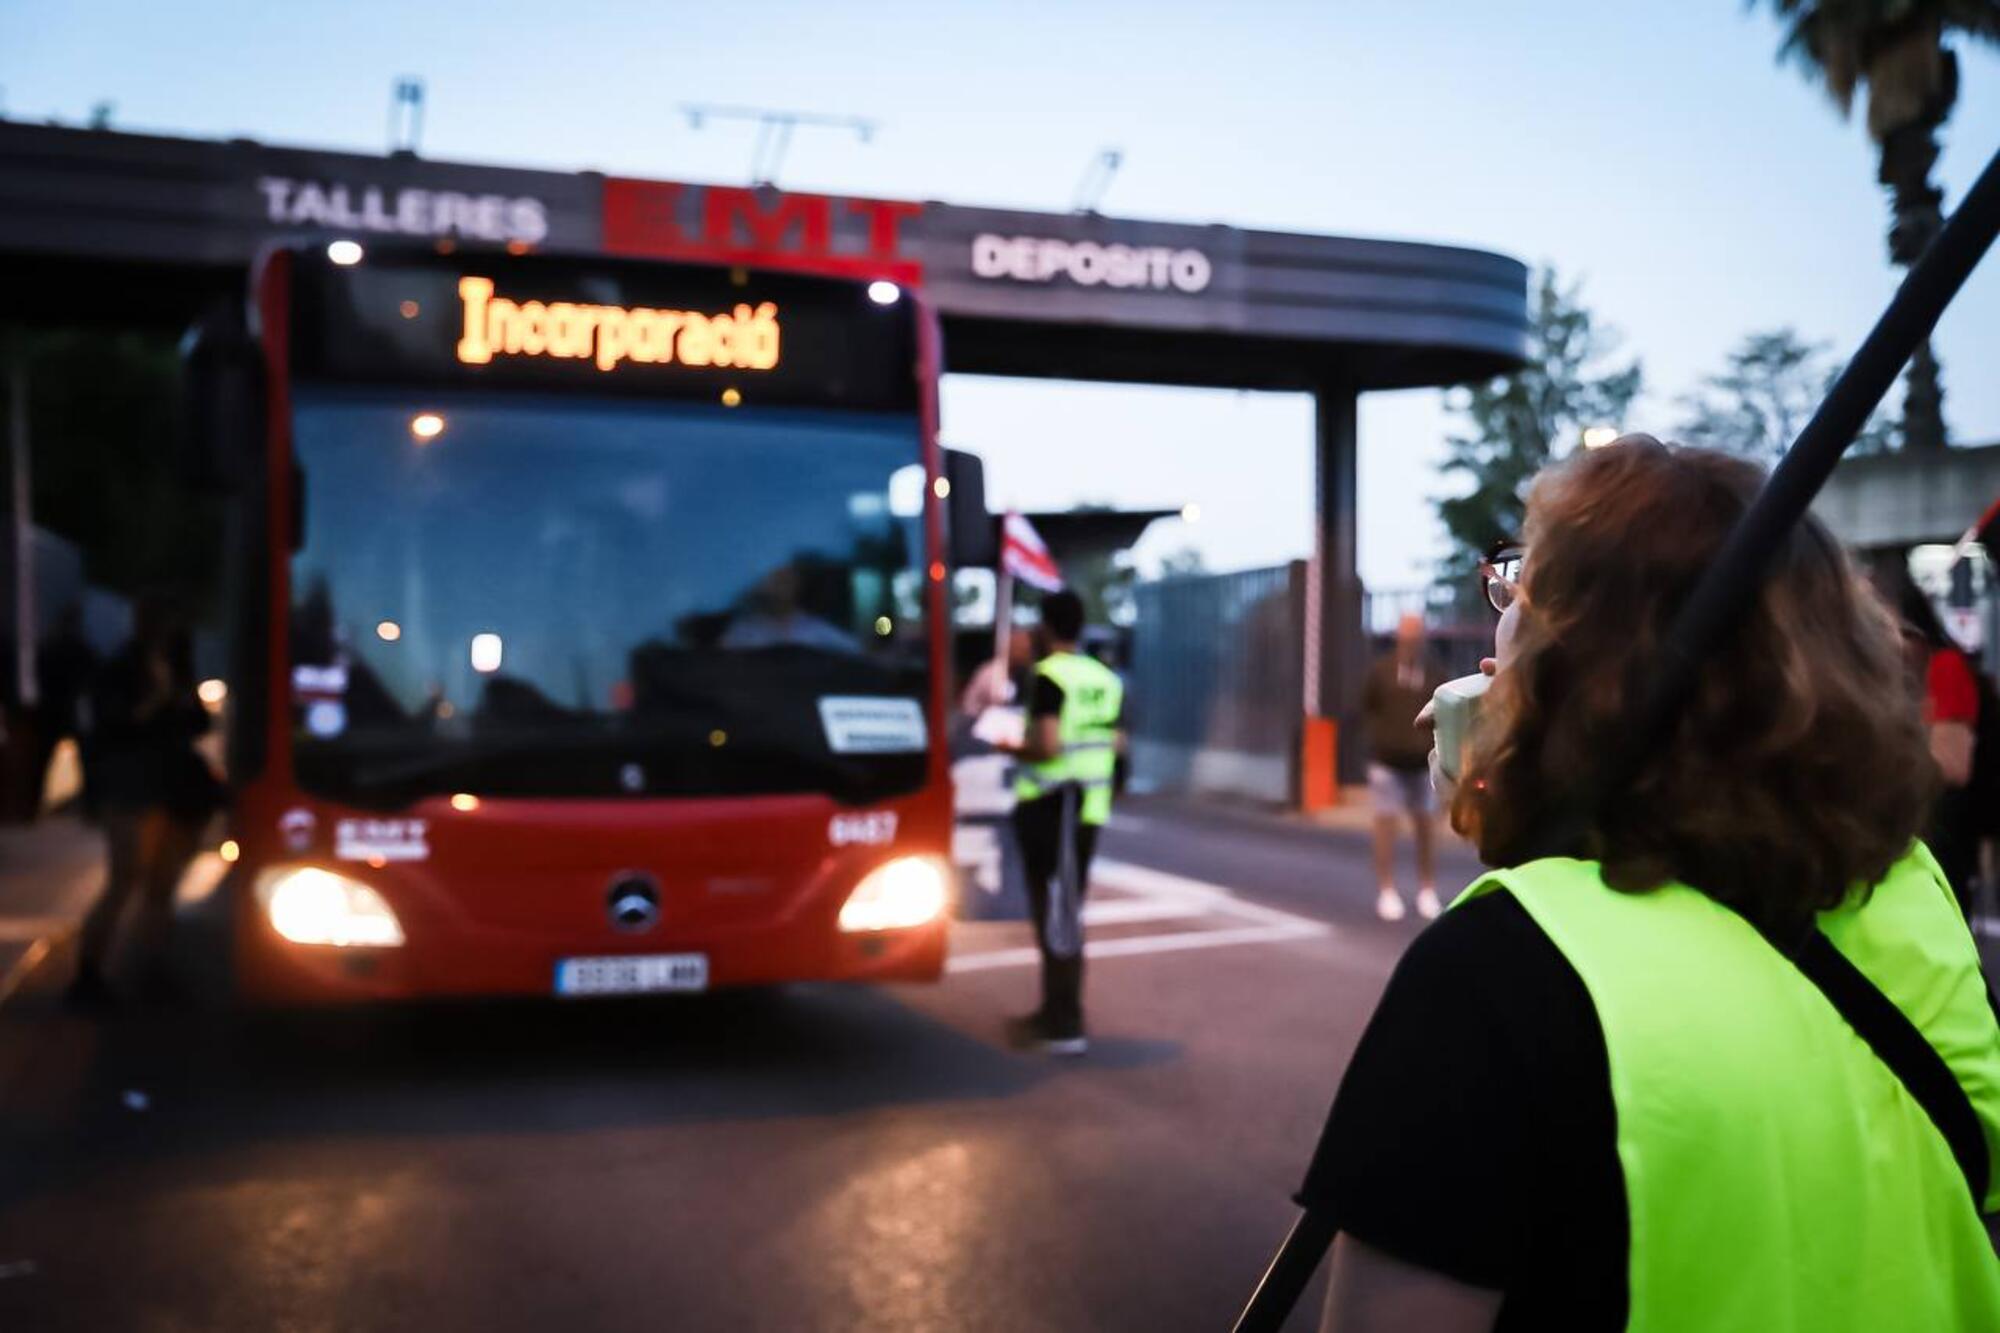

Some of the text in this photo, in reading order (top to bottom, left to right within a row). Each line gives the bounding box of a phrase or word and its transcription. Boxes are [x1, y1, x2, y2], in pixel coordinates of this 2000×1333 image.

[259, 176, 548, 242] TALLERES
[603, 178, 924, 259] EMT
[971, 233, 1212, 293] DEPOSITO
